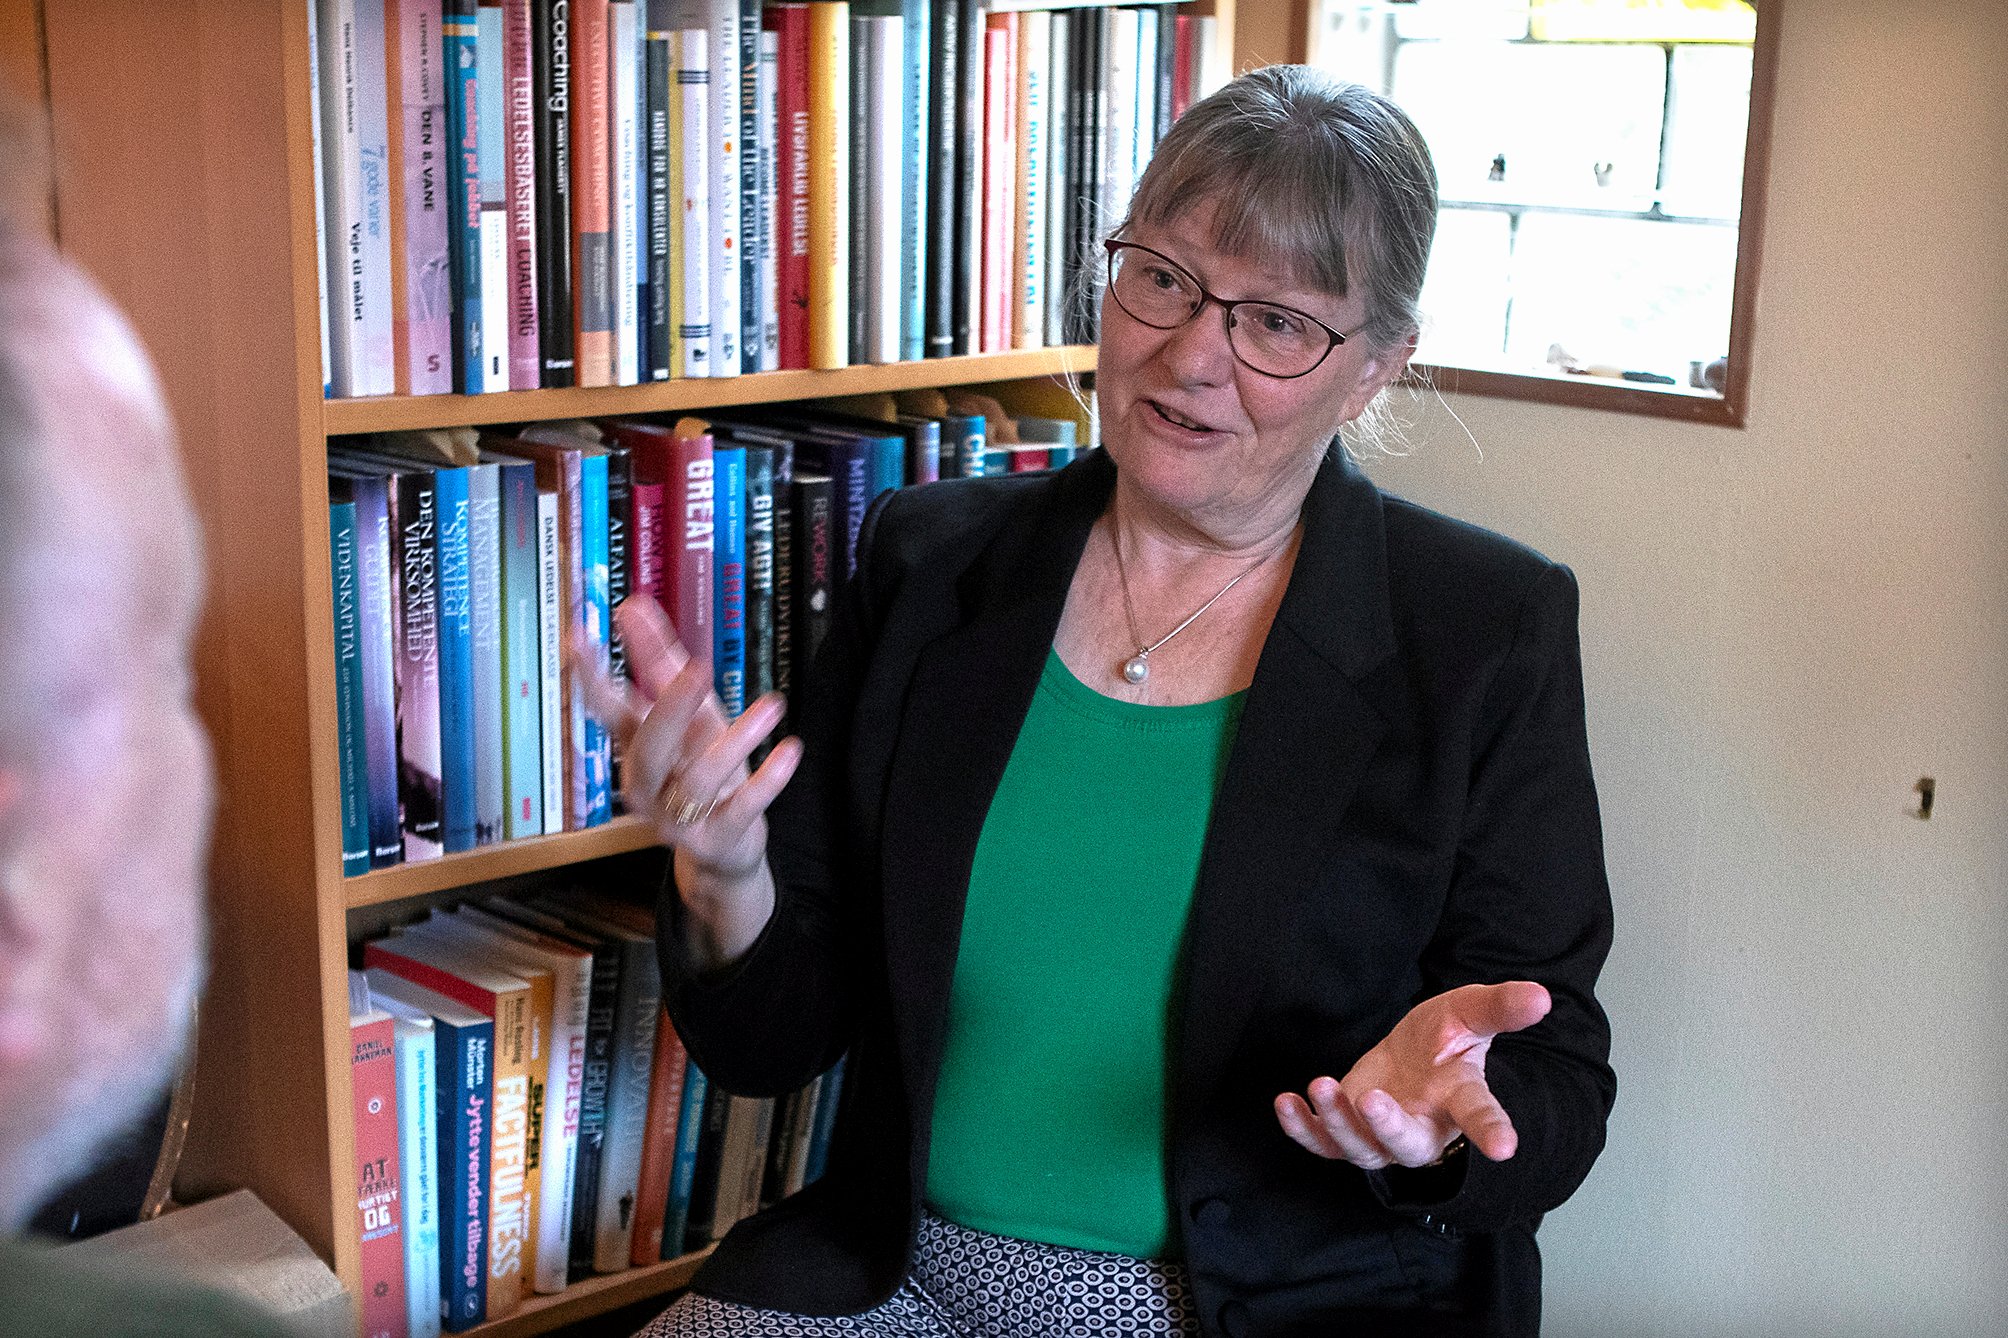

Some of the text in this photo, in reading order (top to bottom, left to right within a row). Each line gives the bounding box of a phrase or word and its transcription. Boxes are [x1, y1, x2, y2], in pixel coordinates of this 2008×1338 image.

[548, 0, 570, 112] Coaching
[741, 16, 759, 54] The
[463, 78, 479, 149] Coaching
[742, 60, 760, 114] Mind
[420, 110, 433, 146] DEN
[511, 76, 534, 244] LEDELSESBASERET
[742, 120, 760, 142] of
[361, 145, 386, 239] 7 gode vaner
[422, 167, 436, 212] VANE
[464, 153, 480, 174] på
[556, 148, 569, 195] FLAHERTY
[742, 148, 760, 183] the
[465, 177, 481, 229] jobbet
[653, 192, 667, 256] KONSULENTER
[742, 188, 761, 266] Leader
[791, 198, 809, 256] LEDELSE
[349, 222, 366, 322] Veje til målet
[515, 247, 535, 337] COACHING
[543, 517, 556, 557] DANSK
[651, 503, 665, 556] HOW
[685, 459, 715, 553] GREAT
[728, 462, 739, 554] Collins and Hansen
[752, 494, 773, 532] GIV
[441, 522, 459, 618] STRATEGI
[455, 499, 471, 637] KOMPETENCE
[473, 498, 491, 651] MANAGEMENT
[639, 504, 653, 586] JIM COLLINS
[752, 539, 773, 591] AGT!
[812, 499, 828, 585] REWORK
[336, 527, 354, 663] VIDENKAPITAL
[404, 521, 422, 661] VIRKSOMHED
[419, 490, 438, 687] DEN KOMPETENTE
[545, 559, 557, 605] LEDELSE
[697, 576, 707, 626] COLLINS
[722, 562, 742, 630] GREAT
[776, 508, 792, 692] LEDERUDVIKLIN
[723, 637, 742, 665] BY
[342, 850, 370, 862] Børsen
[375, 844, 401, 857] Børsen
[465, 1037, 478, 1090] Münster
[475, 1037, 488, 1085] Morten
[510, 1025, 525, 1064] Rosling
[623, 995, 659, 1142] INNOVATI
[562, 1035, 586, 1139] LEDELSE
[581, 1060, 609, 1136] GROWTH
[528, 1083, 545, 1171] SUPER
[362, 1159, 389, 1183] AT
[463, 1094, 485, 1288] Jytte vender tilbage
[490, 1074, 528, 1281] FACTFULNESS
[364, 1204, 392, 1231] OG
